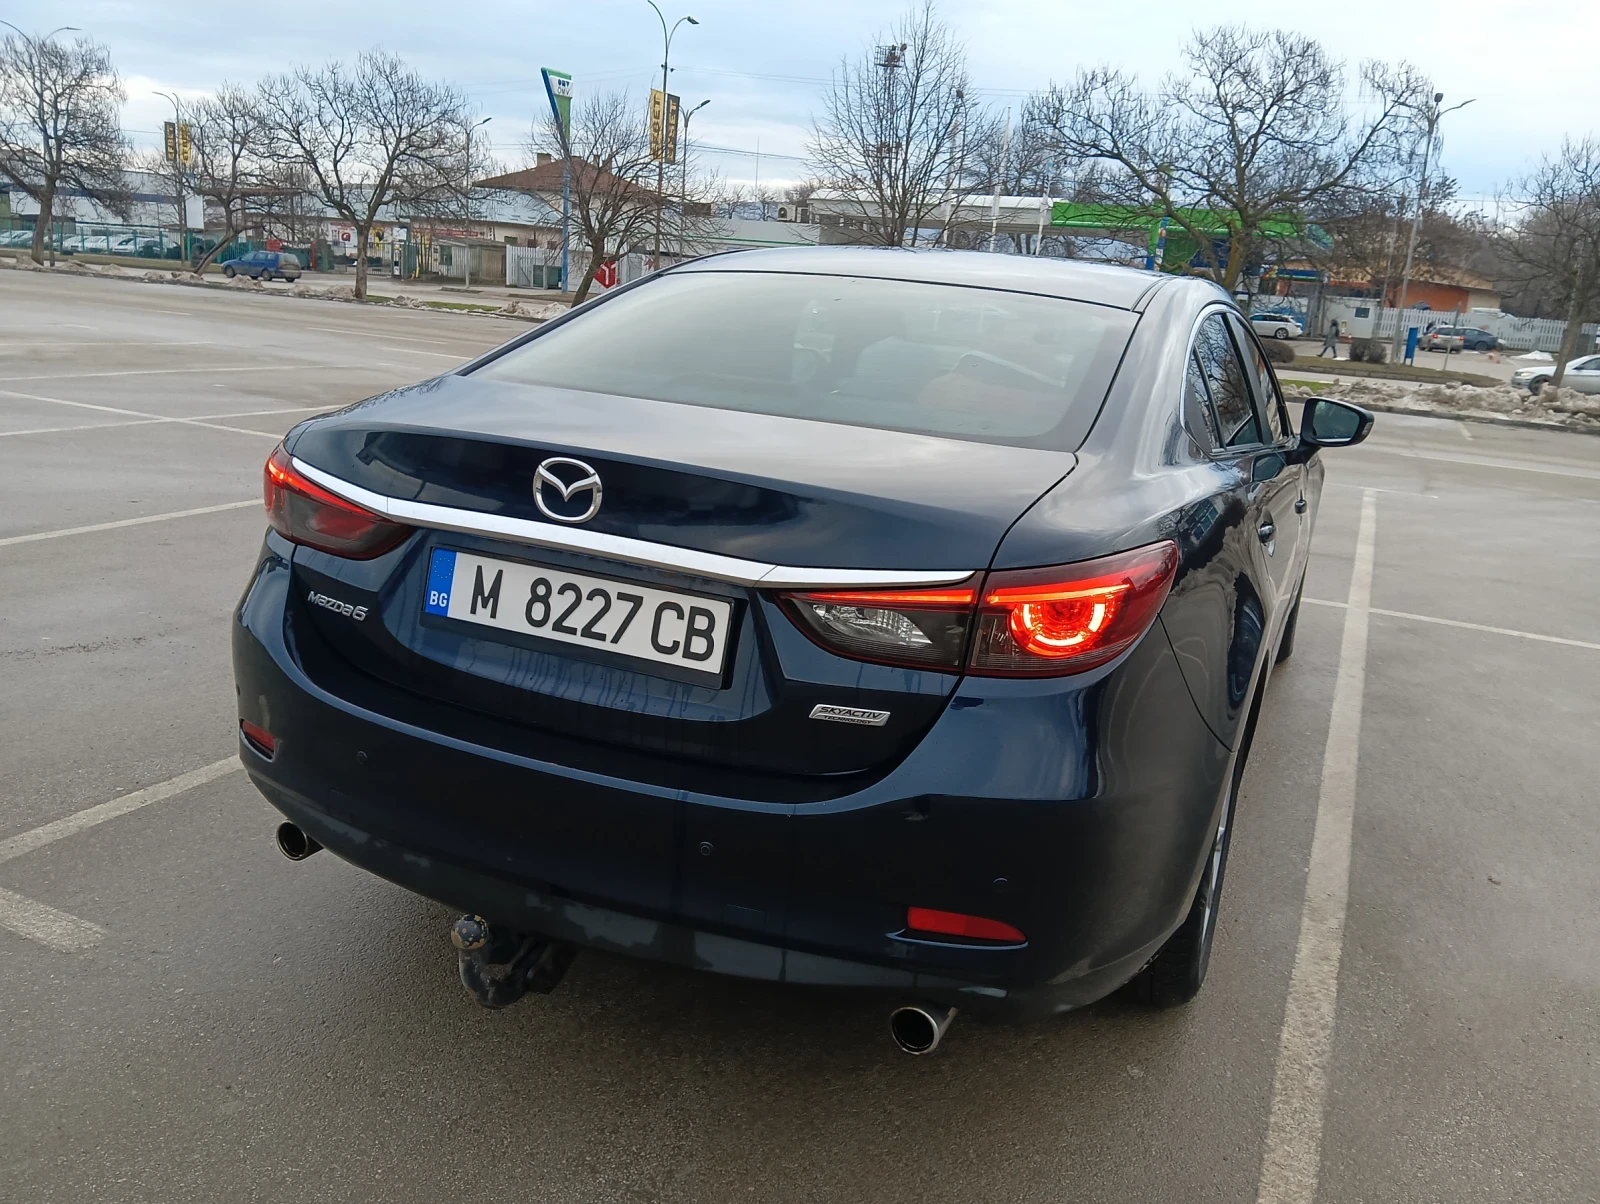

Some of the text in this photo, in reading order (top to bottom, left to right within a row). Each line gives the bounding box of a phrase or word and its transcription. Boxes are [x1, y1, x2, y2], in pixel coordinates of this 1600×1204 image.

[429, 590, 448, 607] BG
[470, 564, 716, 662] M 8227 CB
[819, 706, 882, 719] SKYACTIV
[824, 715, 872, 725] TECHNOLOGY
